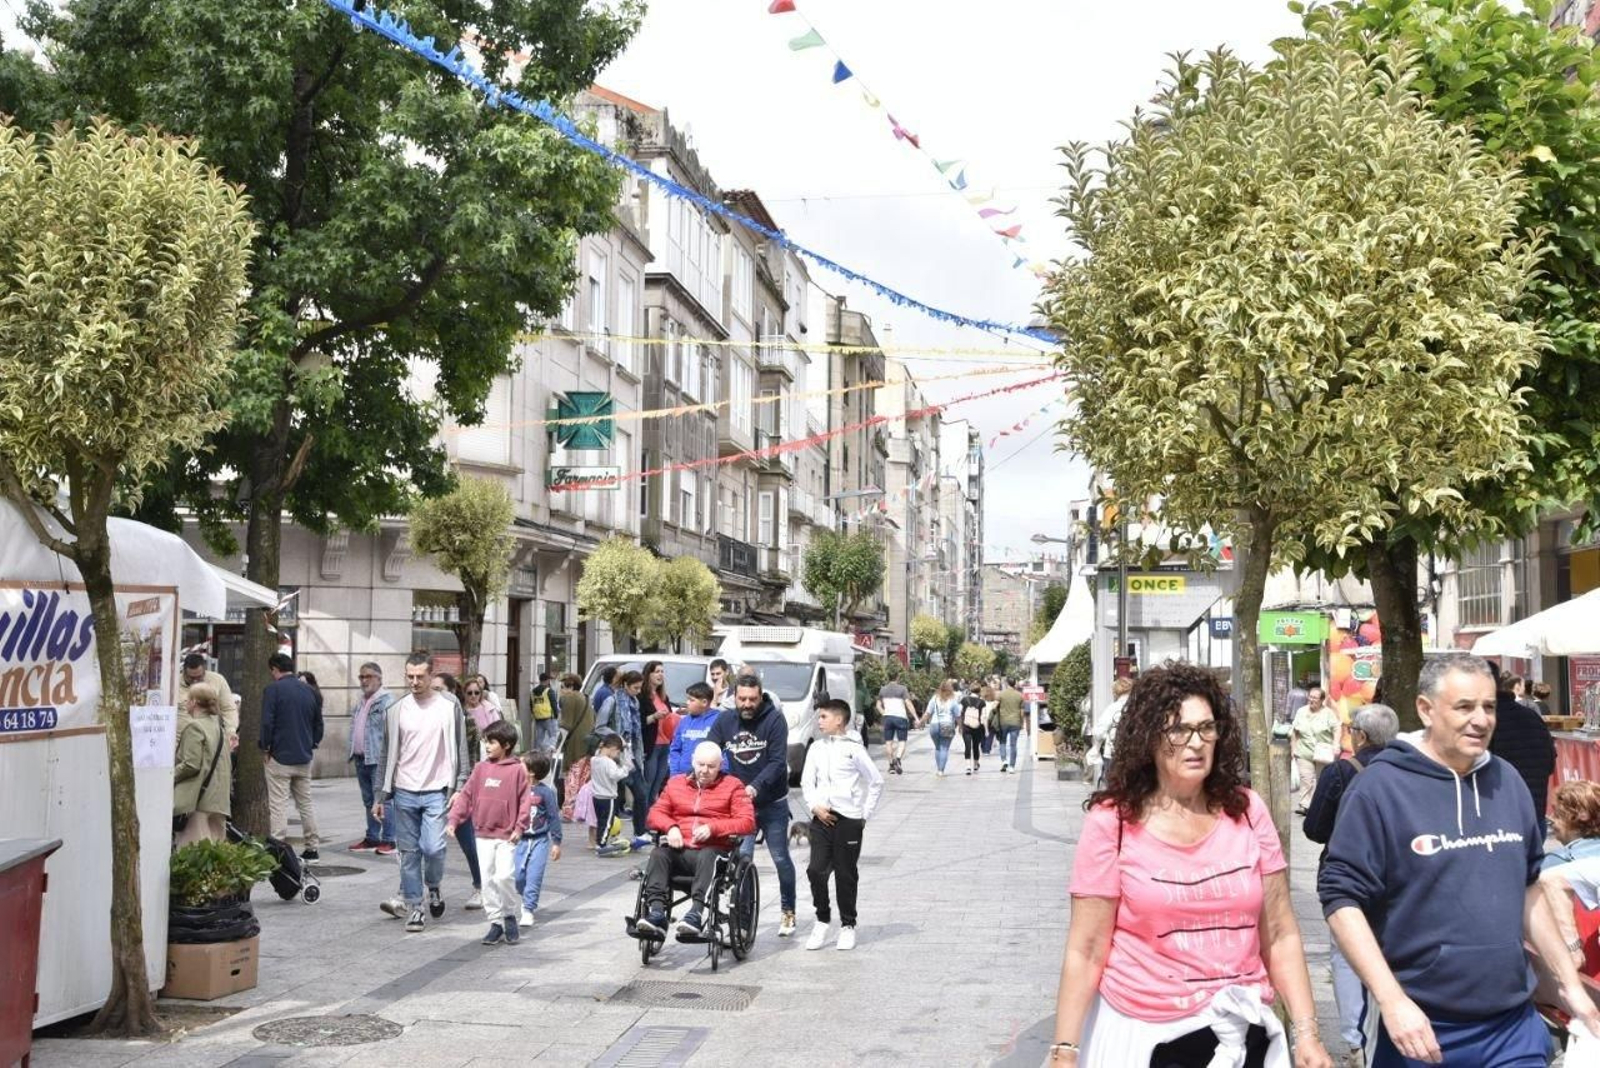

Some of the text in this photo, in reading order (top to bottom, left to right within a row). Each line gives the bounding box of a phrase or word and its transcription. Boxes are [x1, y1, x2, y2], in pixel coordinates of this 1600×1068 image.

[1131, 579, 1178, 591] ONCE
[40, 710, 55, 728] 74
[1411, 829, 1523, 856] Champion
